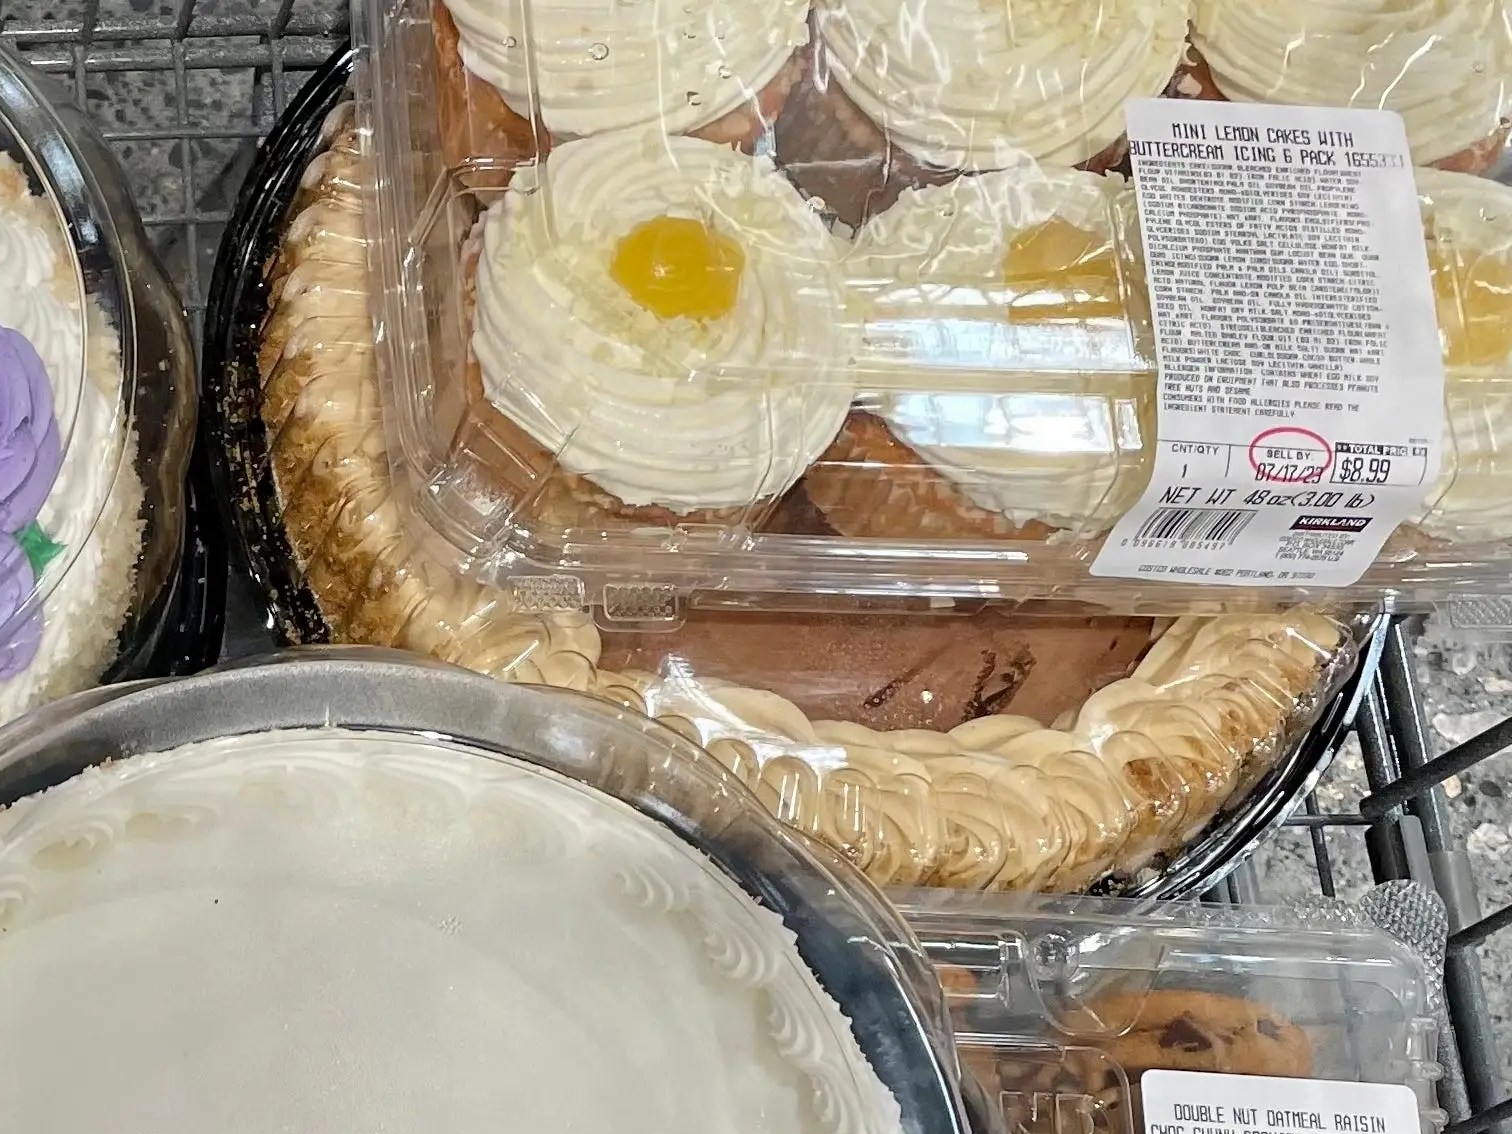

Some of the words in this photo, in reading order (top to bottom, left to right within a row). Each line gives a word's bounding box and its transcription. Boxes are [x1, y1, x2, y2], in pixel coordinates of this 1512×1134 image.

[1172, 123, 1207, 140] MINI
[1215, 125, 1260, 143] LEMON
[1267, 128, 1311, 145] CAKES
[1318, 130, 1354, 147] WITH
[1129, 141, 1224, 158] BUTTERCREAM
[1234, 146, 1276, 163] ICING
[1284, 148, 1292, 163] 6
[1301, 149, 1336, 166] PACK
[1172, 444, 1219, 456] CNT/QTY
[1267, 450, 1293, 460] SELL
[1349, 444, 1383, 455] TOTAL
[1182, 463, 1187, 478] 1
[1255, 462, 1324, 485] 07/17/23
[1339, 457, 1390, 484] $8.99
[1159, 486, 1202, 504] NET
[1206, 488, 1236, 505] WT
[1344, 492, 1375, 509] lb)
[1298, 516, 1367, 527] KIRKLAND
[1174, 1104, 1224, 1123] DOUBLE
[1233, 1107, 1258, 1126] NUT
[1267, 1110, 1327, 1130] OATMEAL
[1335, 1114, 1386, 1133] RAISIN
